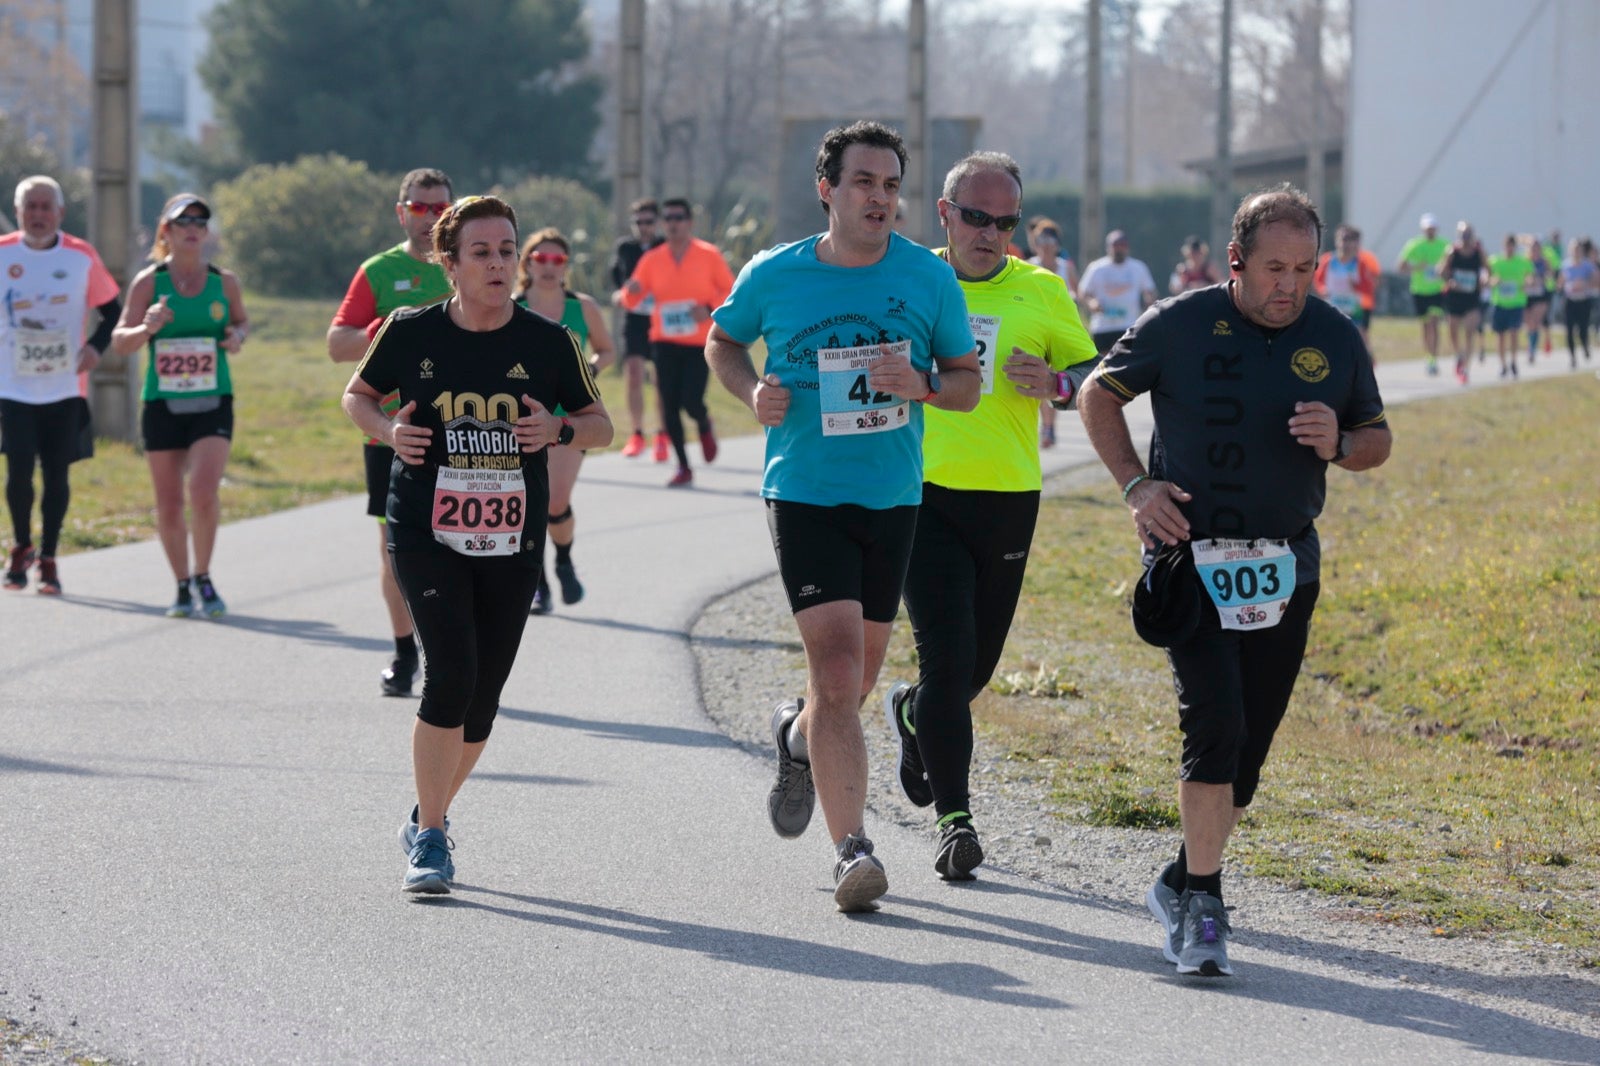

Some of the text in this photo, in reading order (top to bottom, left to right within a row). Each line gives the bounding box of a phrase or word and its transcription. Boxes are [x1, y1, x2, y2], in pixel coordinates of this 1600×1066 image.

[820, 318, 834, 329] DE
[834, 313, 868, 323] FONDO
[824, 350, 841, 361] XXXIII
[841, 347, 858, 360] GRAN
[160, 355, 212, 375] 2292
[506, 372, 530, 380] adidas
[432, 391, 519, 424] 100
[445, 430, 519, 454] BEHOBIA
[1204, 353, 1247, 536] DISUR
[448, 455, 469, 469] SAN
[460, 471, 475, 481] GRAN
[475, 471, 498, 481] PREMIO
[499, 472, 507, 481] DE
[438, 495, 522, 529] 2038
[1212, 563, 1280, 602] 903
